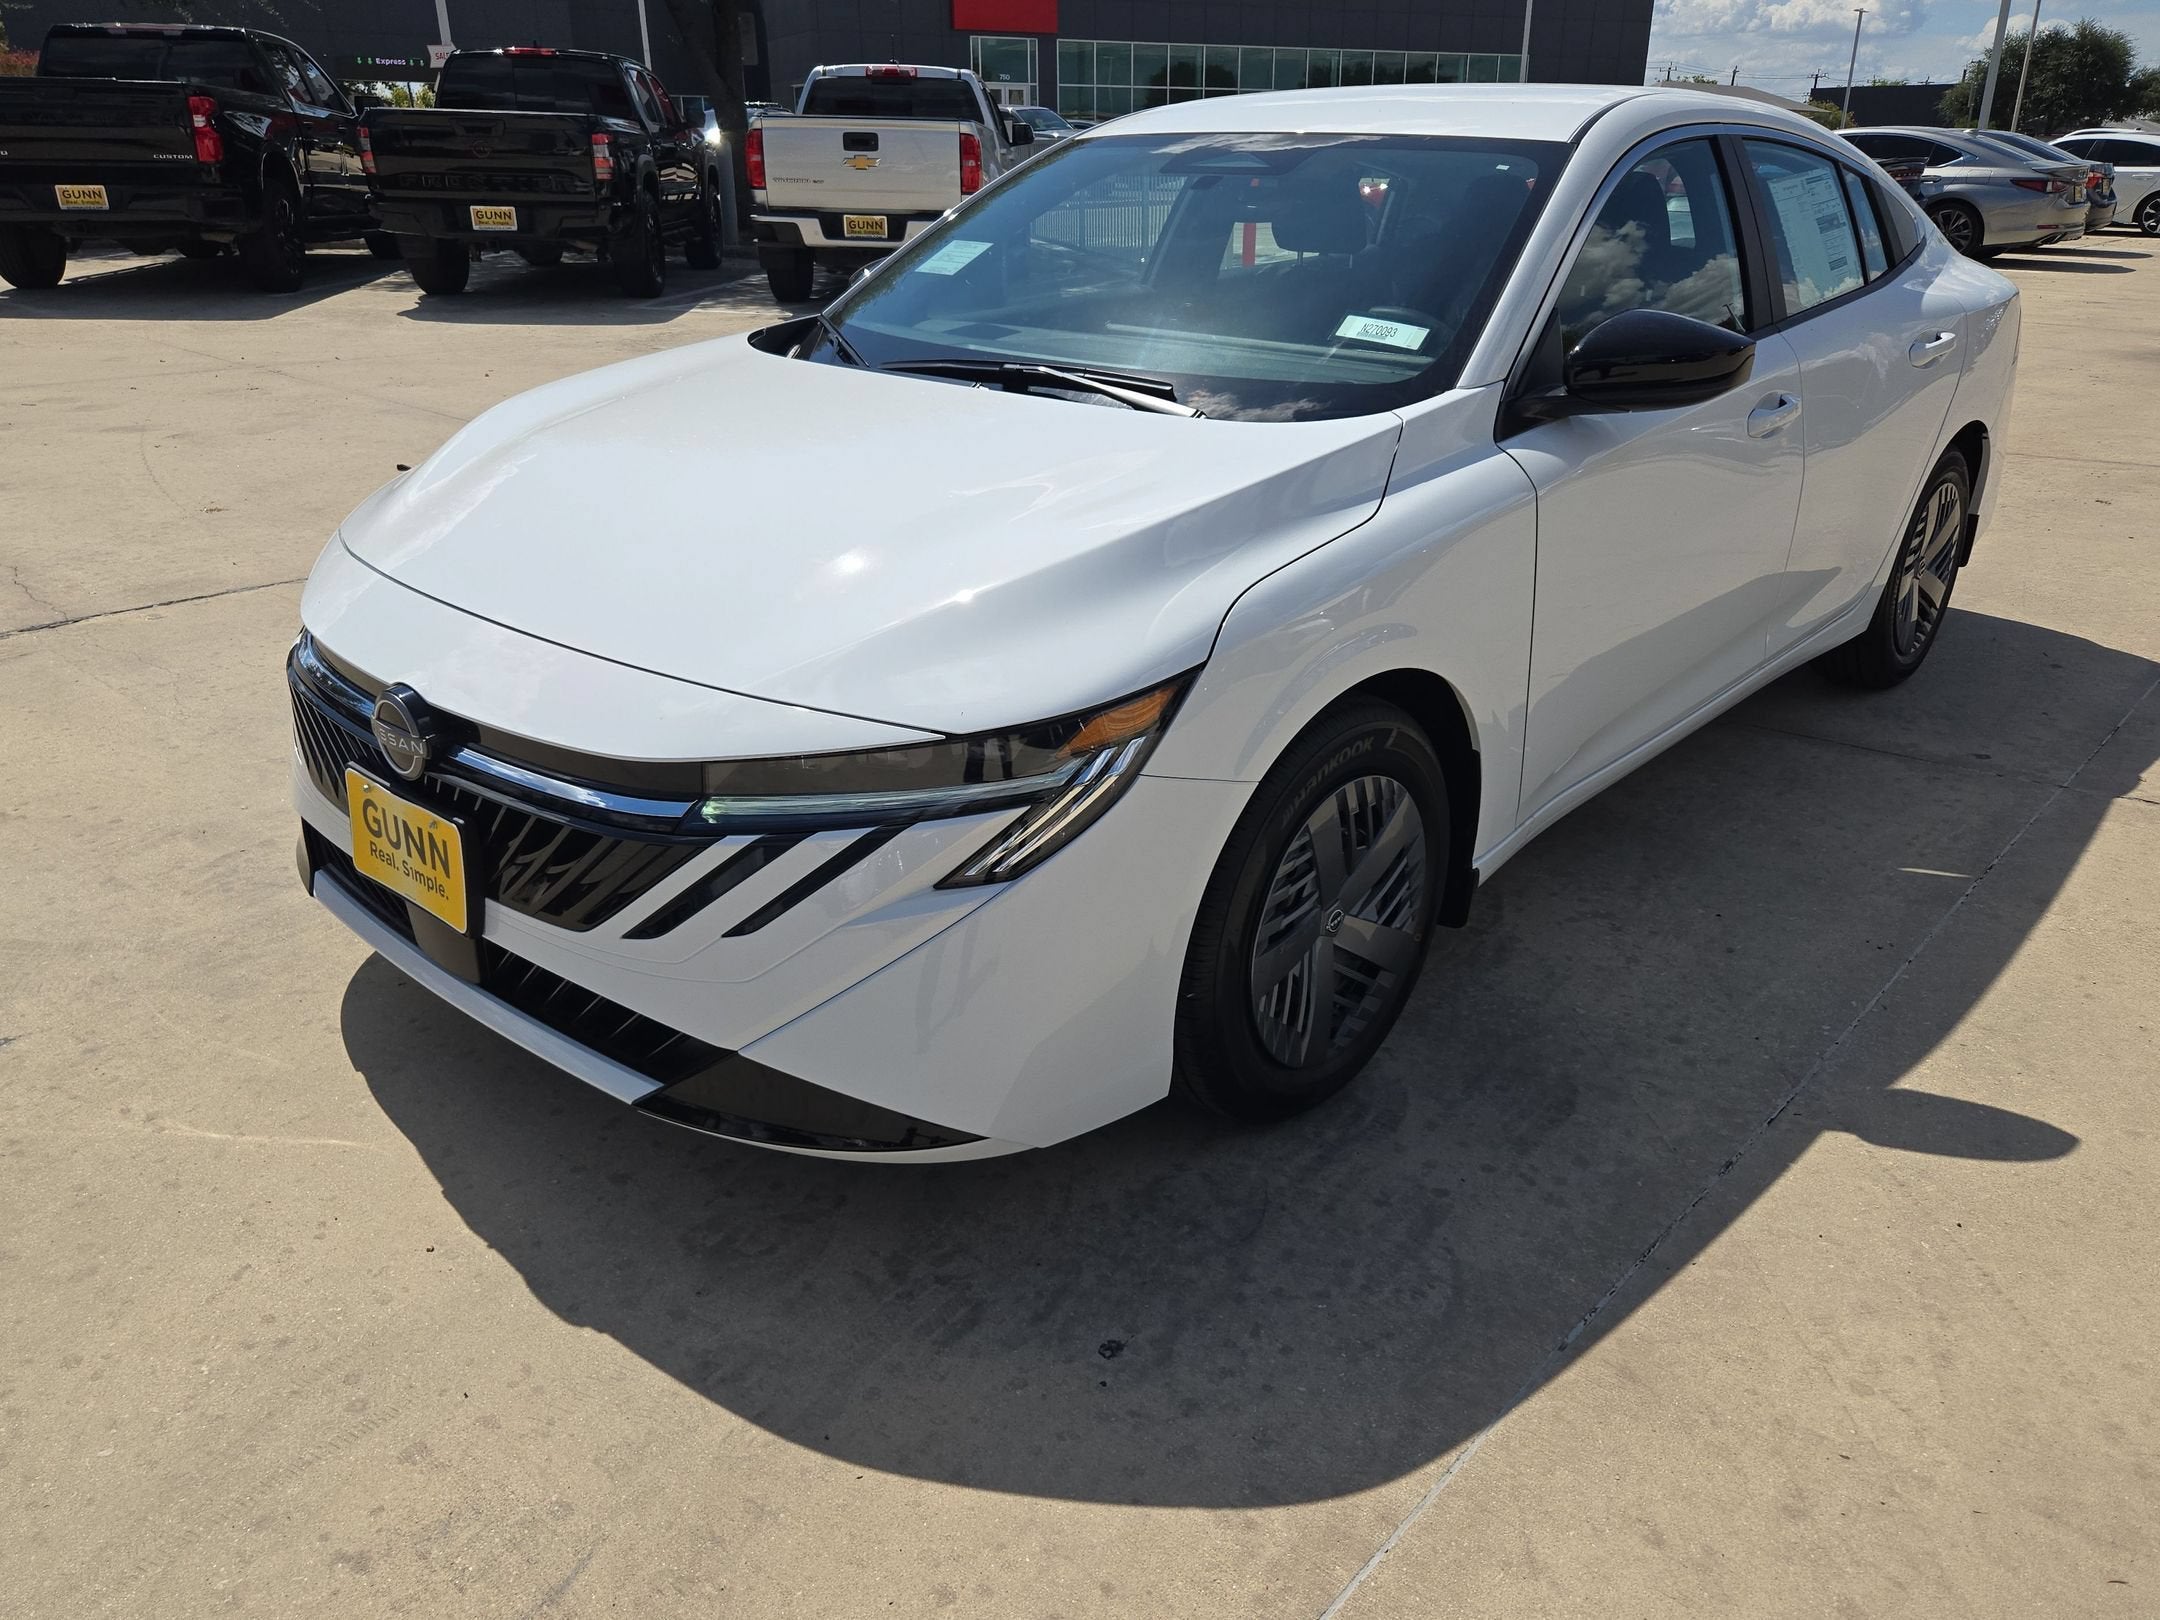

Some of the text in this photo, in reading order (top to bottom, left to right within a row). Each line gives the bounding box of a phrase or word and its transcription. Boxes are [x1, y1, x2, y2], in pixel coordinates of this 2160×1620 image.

[375, 57, 406, 65] Express
[62, 190, 102, 199] GUNN
[476, 210, 512, 220] GUNN
[848, 220, 883, 230] GUNN
[1360, 323, 1398, 337] N270093
[363, 798, 451, 880] GUNN
[370, 840, 450, 900] Real. Simple.
